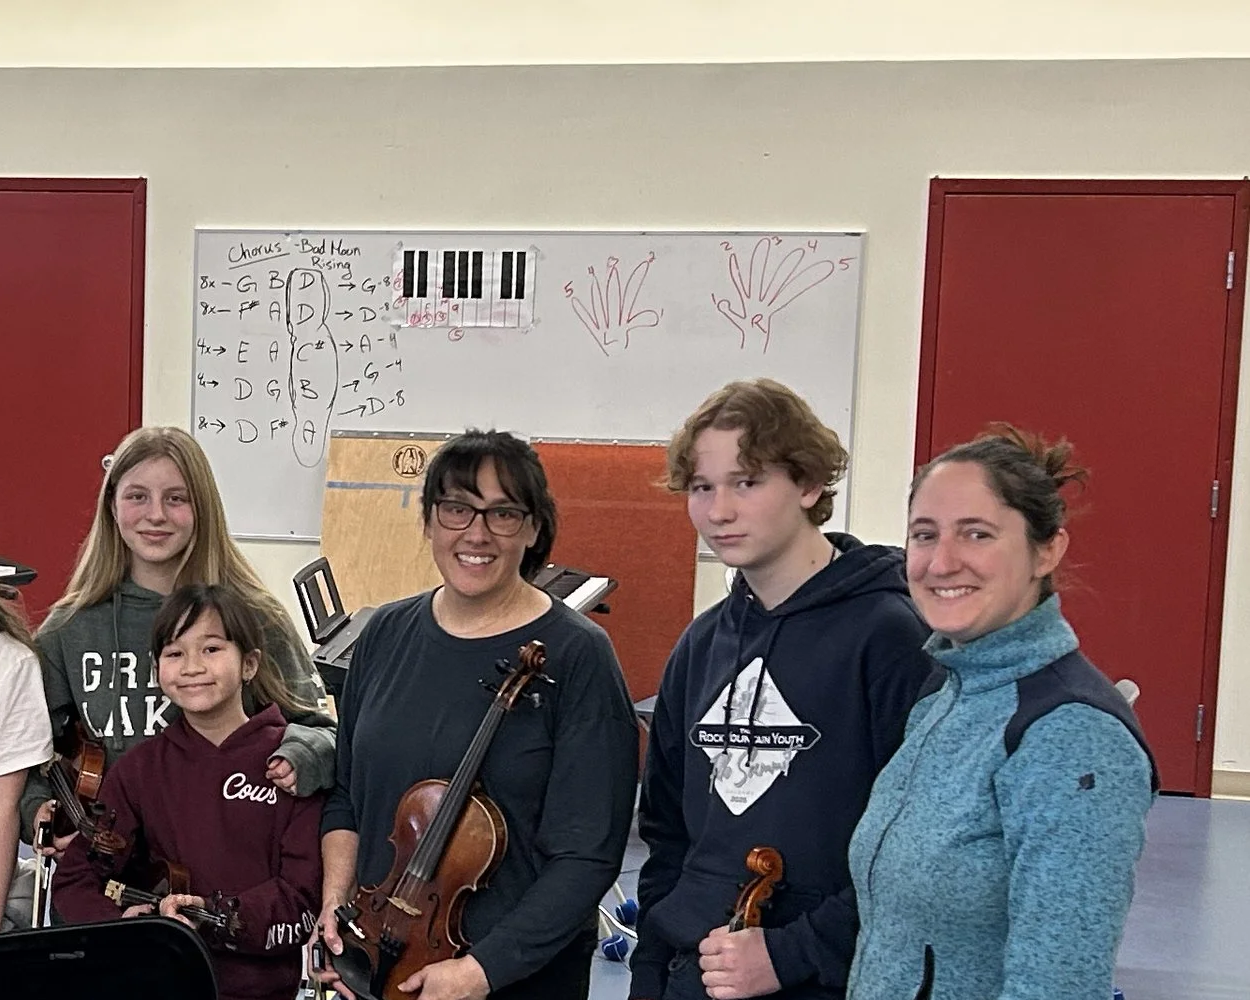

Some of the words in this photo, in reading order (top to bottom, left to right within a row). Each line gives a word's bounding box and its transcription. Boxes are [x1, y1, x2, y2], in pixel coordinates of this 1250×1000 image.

[228, 241, 282, 263] Chorus
[807, 240, 817, 252] 4
[311, 256, 353, 279] Rising
[839, 256, 855, 270] 5
[269, 271, 285, 290] B
[299, 272, 315, 290] D
[564, 280, 574, 297] 5
[269, 301, 281, 322] A
[297, 304, 315, 325] D
[751, 313, 767, 333] R
[238, 341, 249, 362] E
[269, 340, 279, 362] A
[234, 377, 253, 400] D
[266, 380, 281, 401] G
[300, 379, 319, 399] B
[235, 420, 258, 443] D
[302, 420, 316, 444] A
[222, 772, 278, 805] Cows
